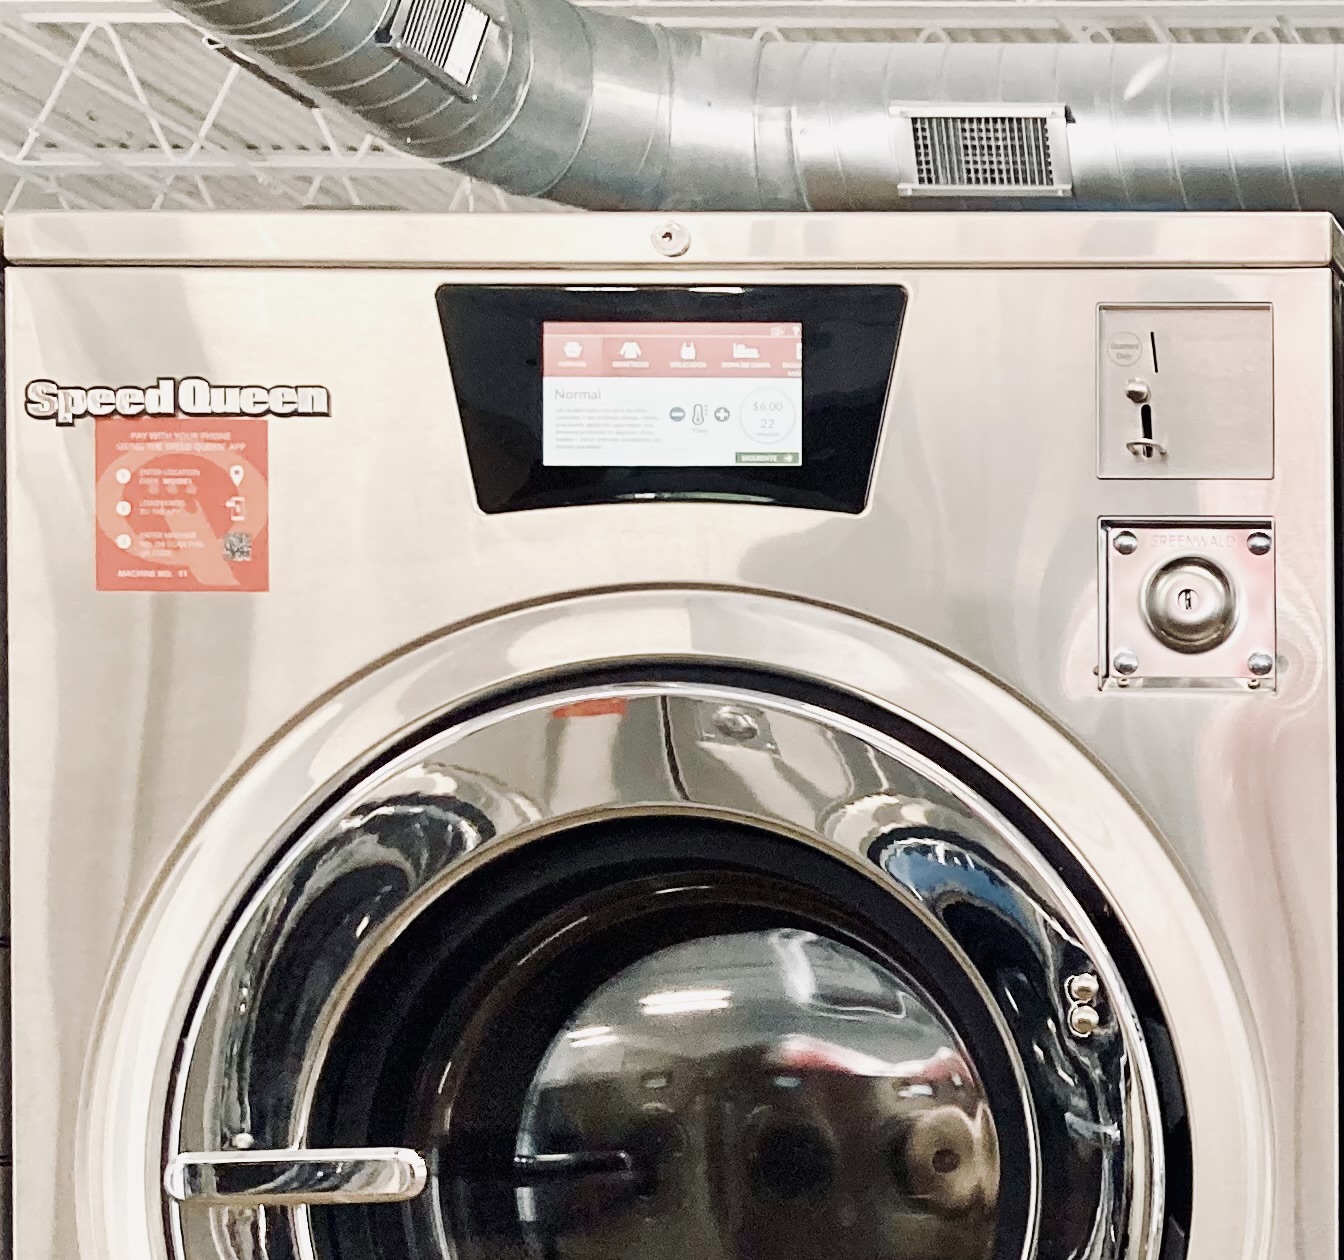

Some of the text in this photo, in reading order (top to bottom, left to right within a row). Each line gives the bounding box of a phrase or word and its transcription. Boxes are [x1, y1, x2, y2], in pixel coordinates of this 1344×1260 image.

[554, 388, 602, 401] Normal
[753, 401, 783, 412] $6.00
[760, 418, 775, 429] 22
[1149, 534, 1236, 547] GREENWALD
